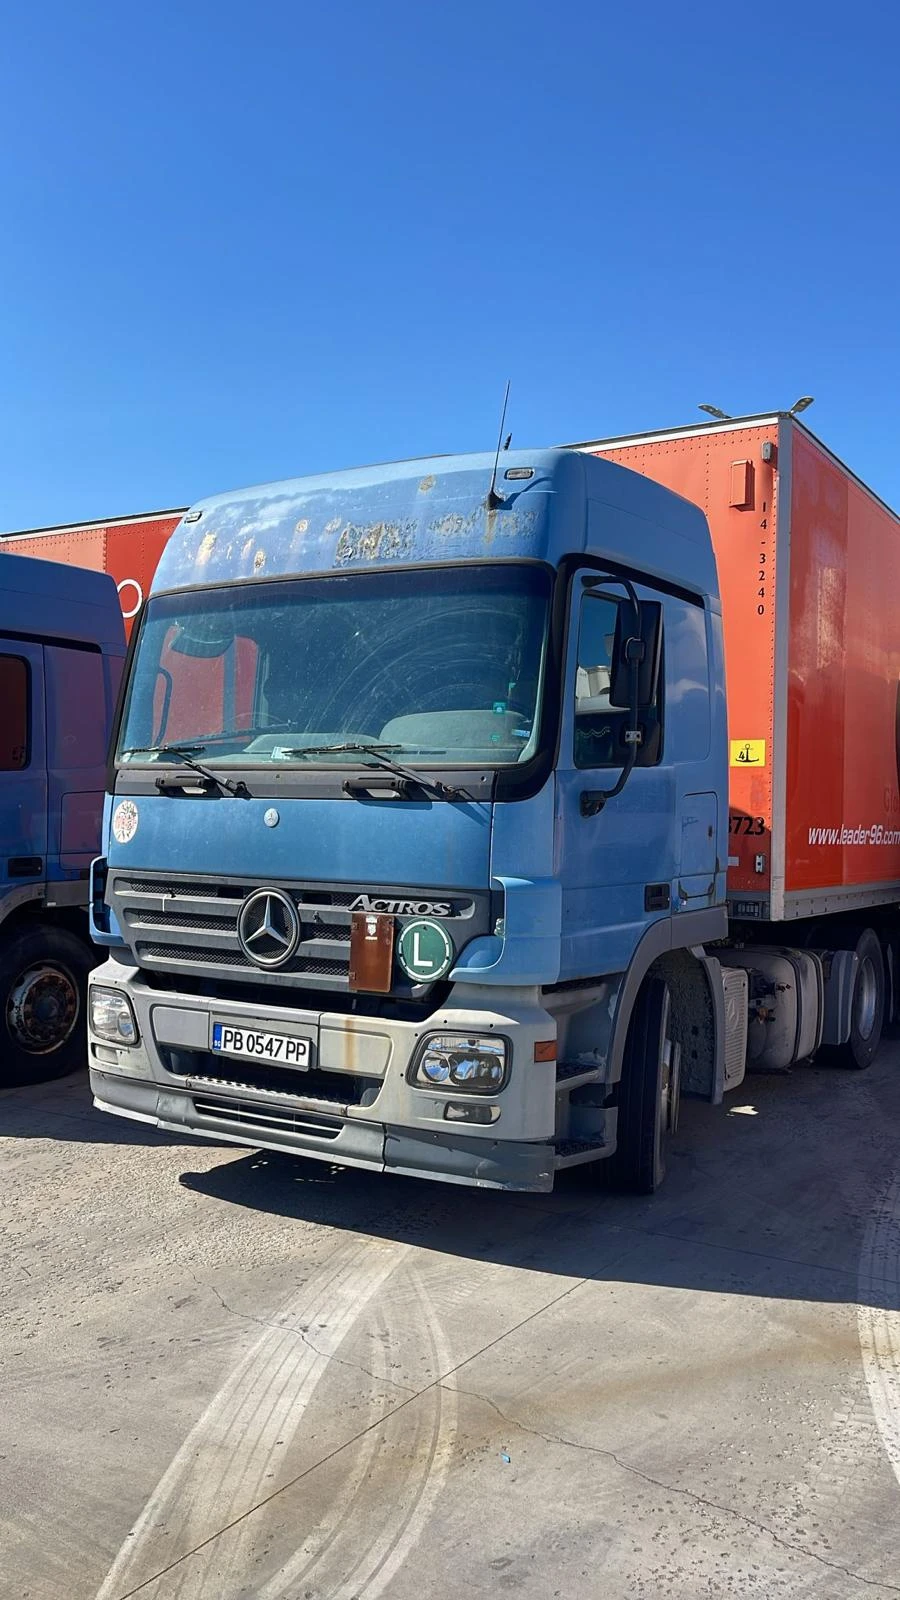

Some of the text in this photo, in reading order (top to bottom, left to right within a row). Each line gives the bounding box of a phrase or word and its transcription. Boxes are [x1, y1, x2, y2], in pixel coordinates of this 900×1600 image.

[757, 502, 768, 616] 14-3240
[738, 751, 746, 760] 4
[808, 824, 900, 845] www.leader96.com
[413, 932, 433, 967] L
[223, 1030, 307, 1062] PB 0547 PP
